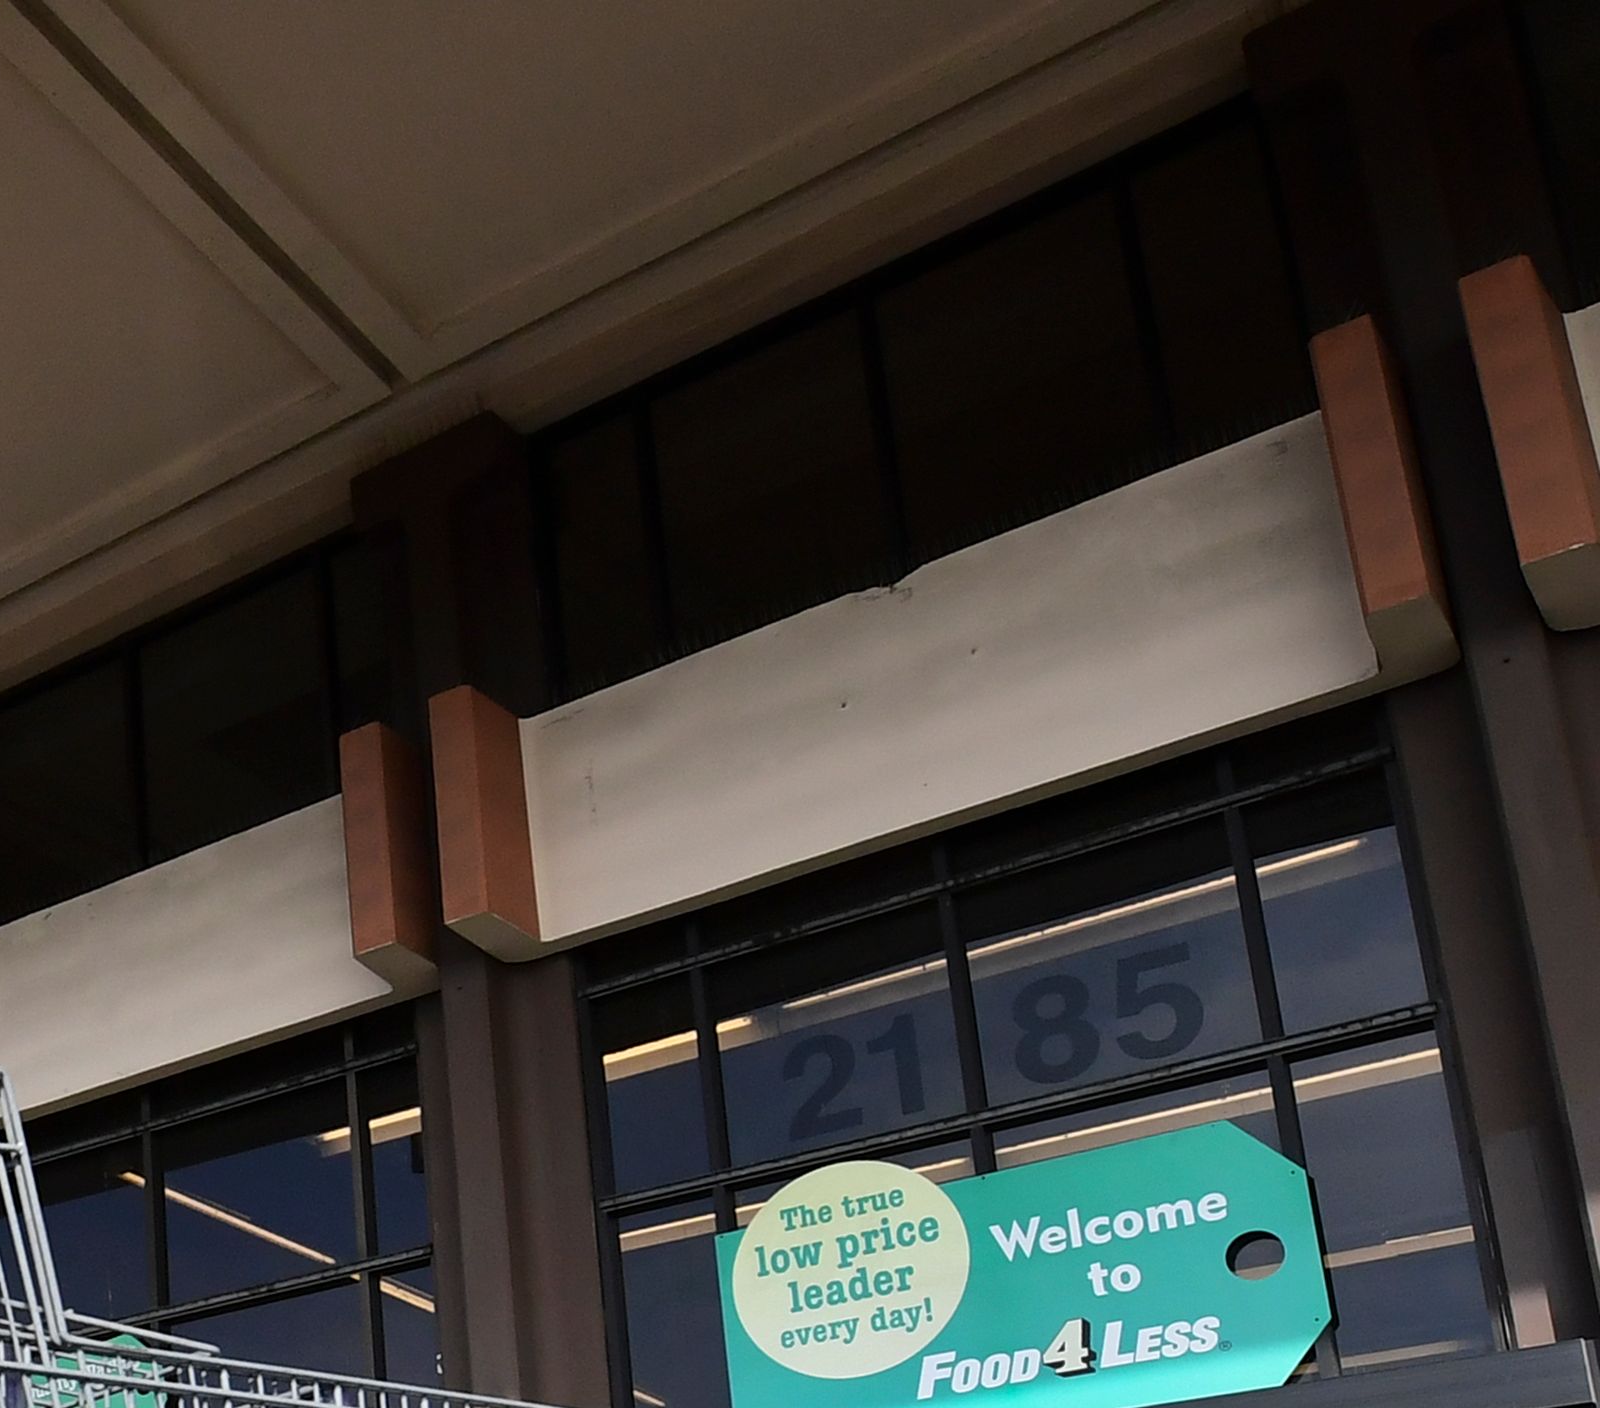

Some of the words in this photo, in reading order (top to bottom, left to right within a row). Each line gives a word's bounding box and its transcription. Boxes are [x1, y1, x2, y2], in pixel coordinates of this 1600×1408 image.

[779, 1204, 833, 1232] The
[841, 1188, 904, 1219] true
[988, 1191, 1229, 1263] Welcome
[754, 1240, 824, 1278] low
[836, 1214, 940, 1270] price
[787, 1264, 915, 1313] leader
[1086, 1261, 1143, 1297] to
[779, 1316, 860, 1349] every
[870, 1297, 933, 1333] day!
